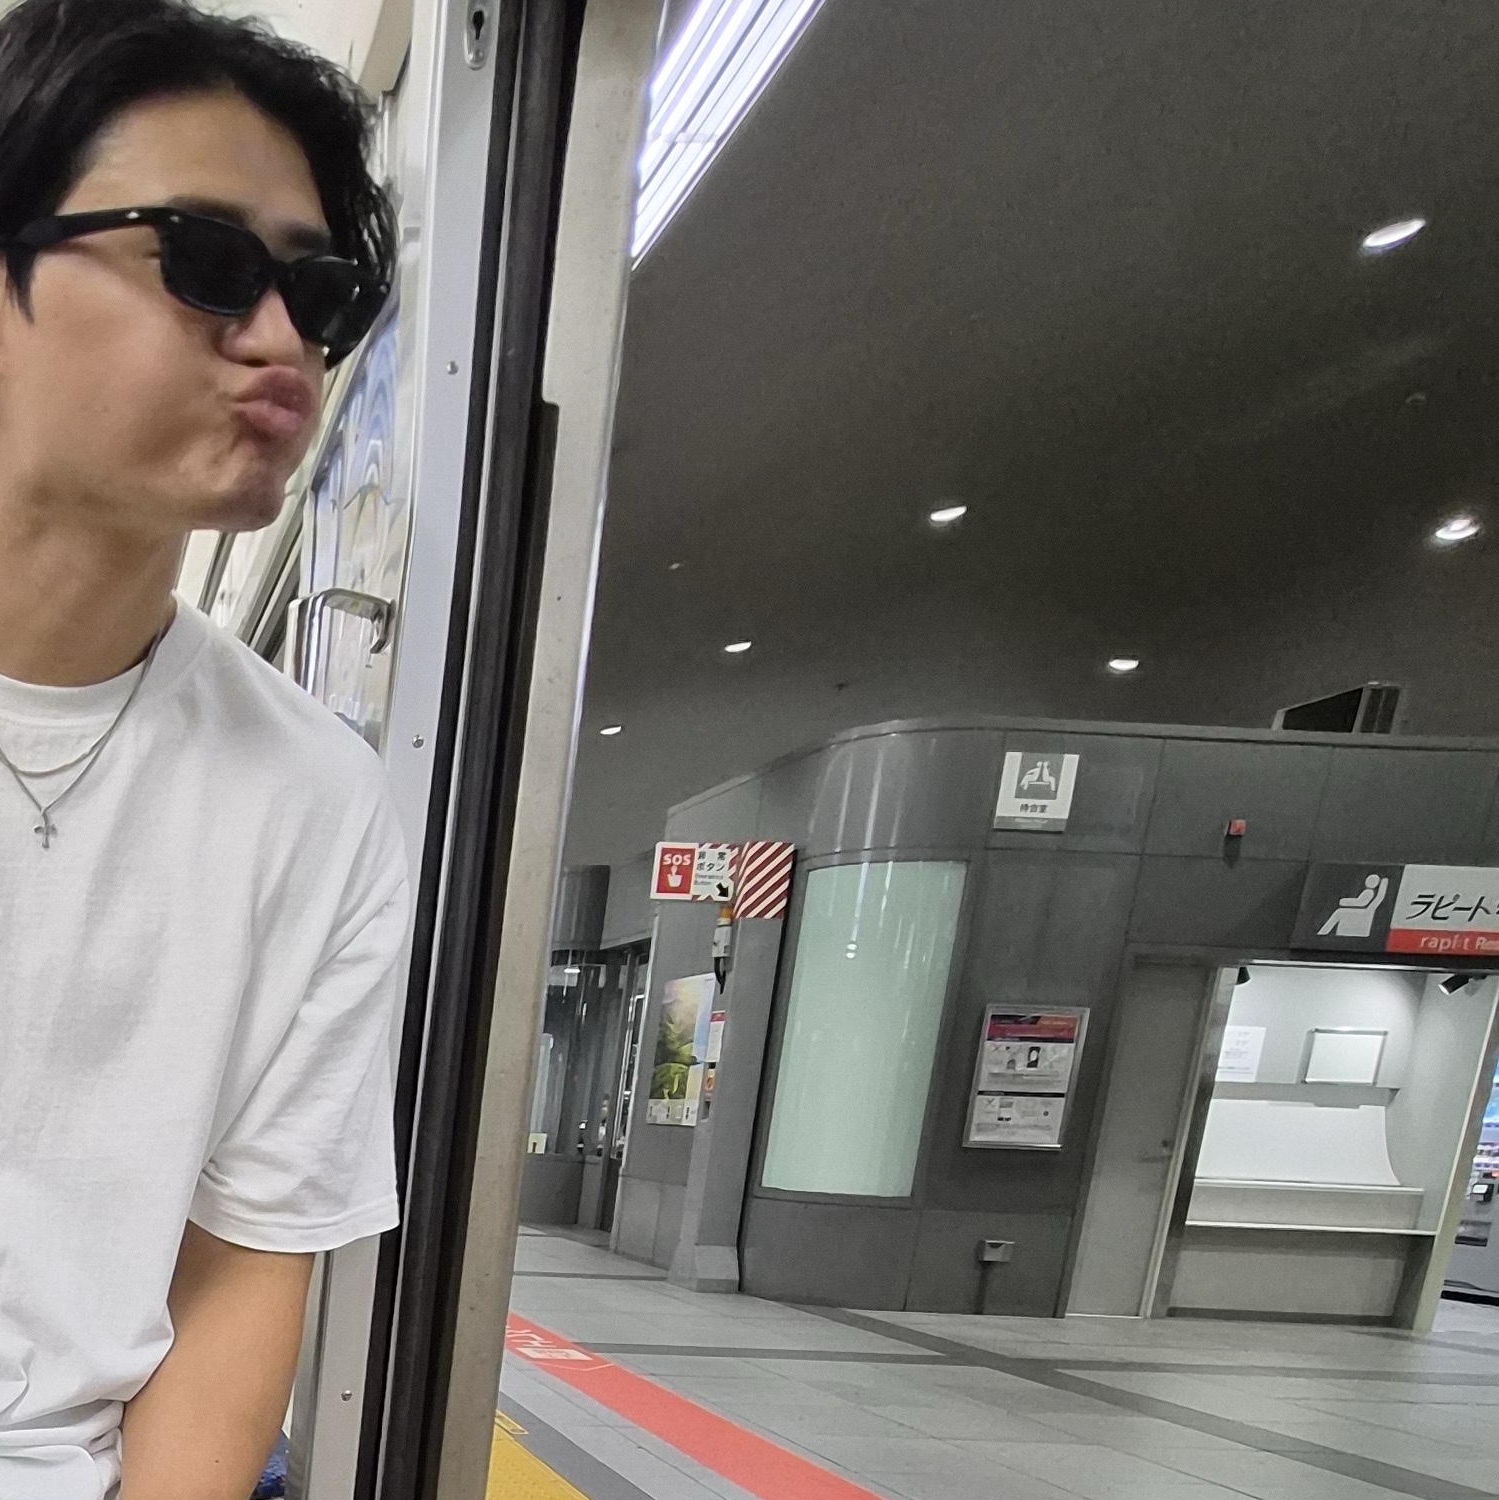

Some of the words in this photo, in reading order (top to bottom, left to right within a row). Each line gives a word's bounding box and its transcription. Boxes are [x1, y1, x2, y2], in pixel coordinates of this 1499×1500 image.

[662, 853, 691, 865] SOS
[1406, 893, 1499, 922] ラピート
